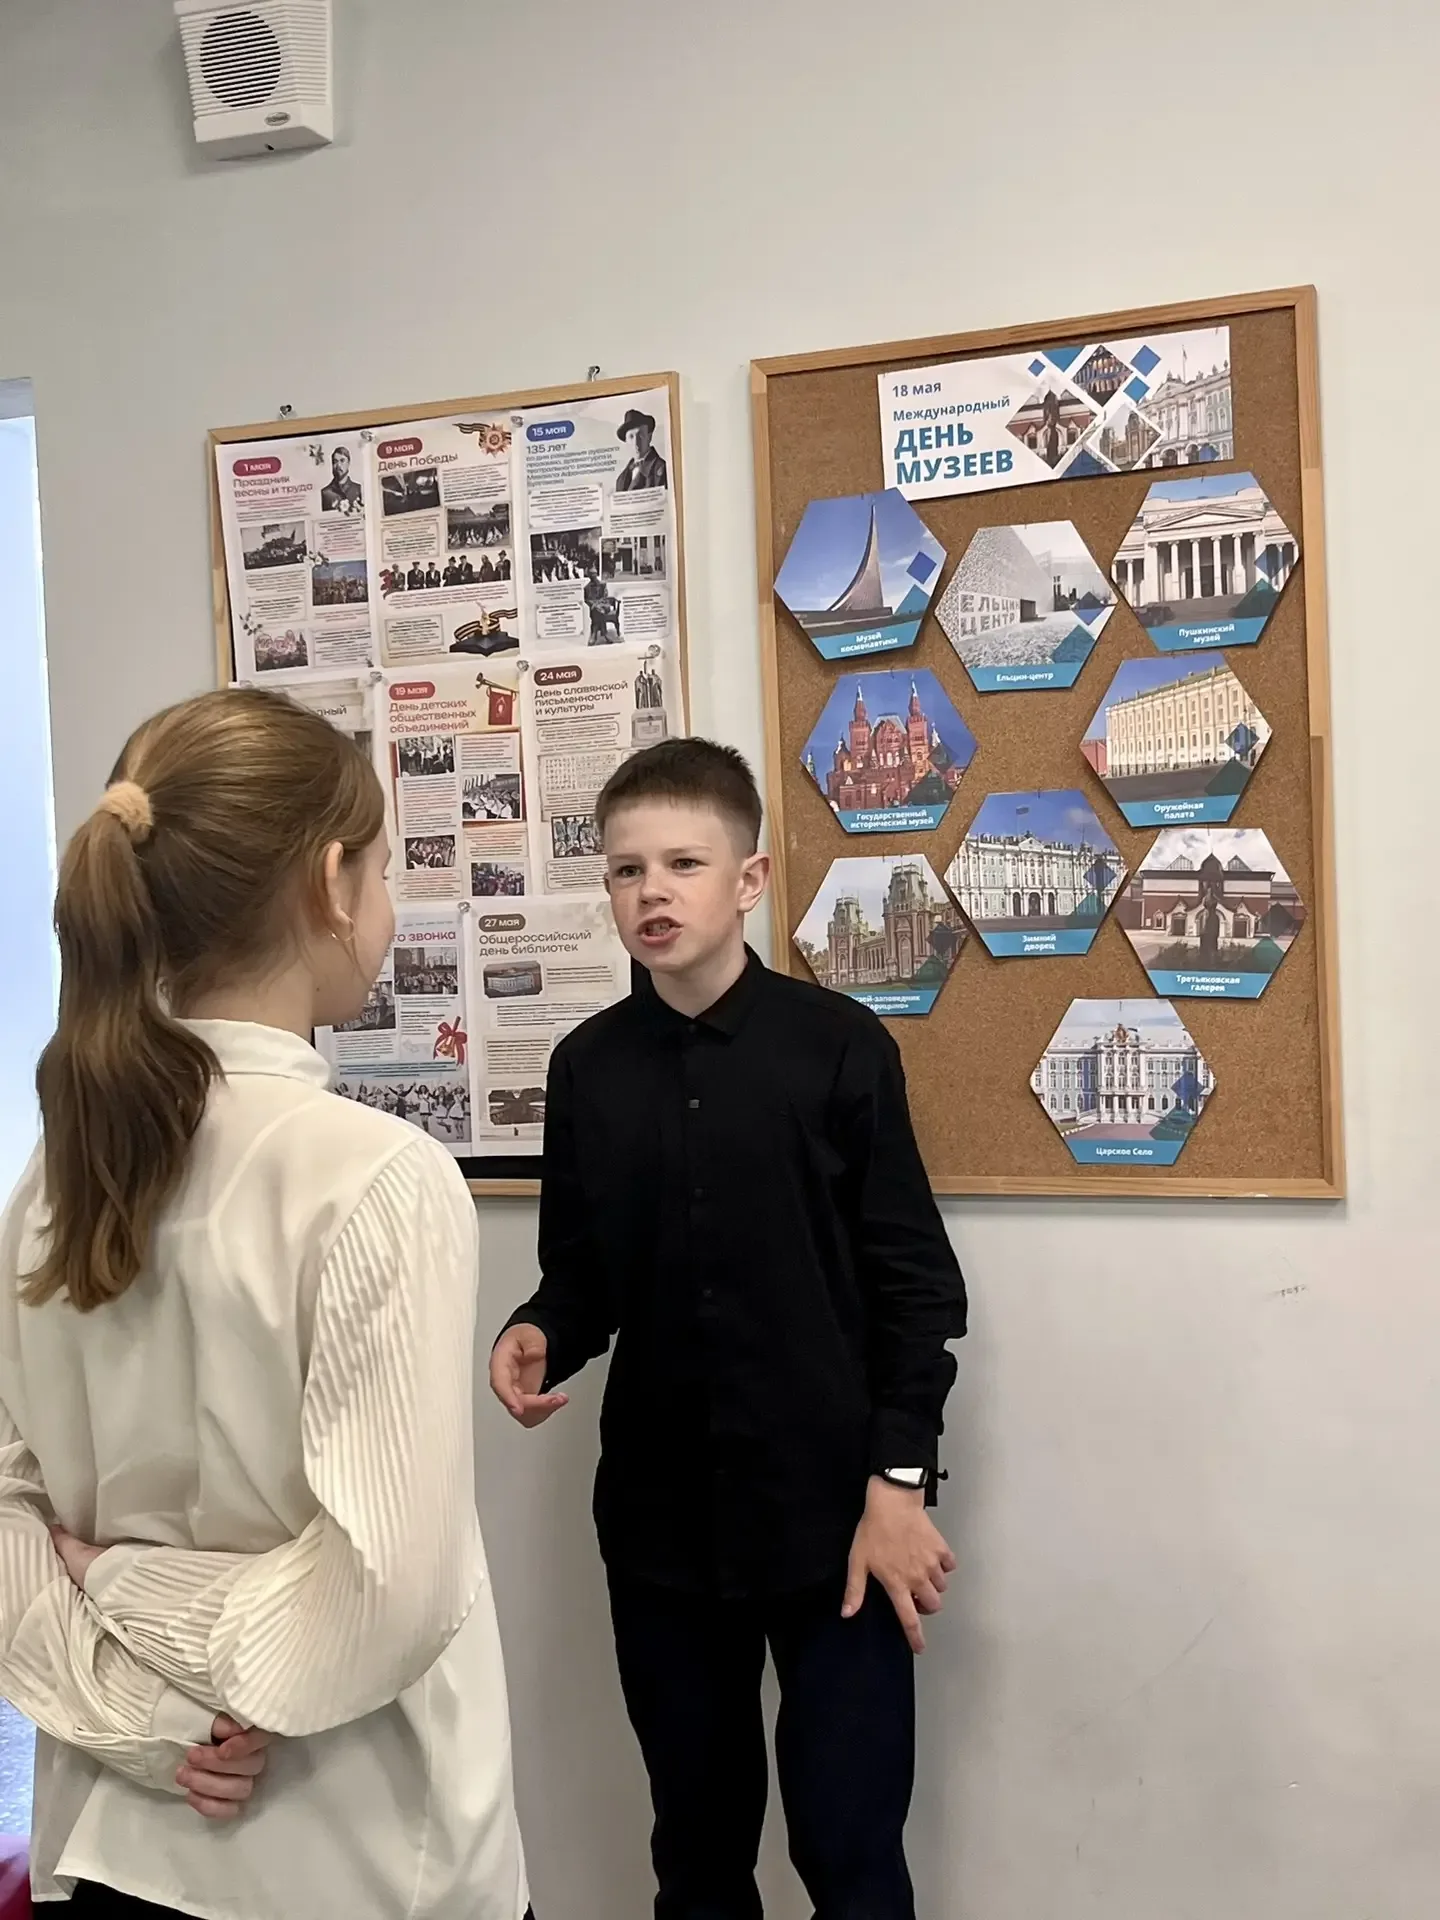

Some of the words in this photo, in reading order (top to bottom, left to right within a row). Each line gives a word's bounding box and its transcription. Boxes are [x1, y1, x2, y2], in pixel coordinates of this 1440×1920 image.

[892, 384, 909, 397] 18
[912, 382, 942, 395] мая
[893, 395, 1011, 422] Международный
[531, 427, 544, 437] 15
[545, 426, 567, 435] мая
[894, 422, 974, 460] ДЕНЬ
[385, 445, 393, 454] 9
[394, 443, 414, 452] мая
[526, 444, 546, 454] 135
[547, 443, 567, 453] лет
[378, 460, 407, 472] День
[409, 453, 459, 466] Победы
[896, 449, 1014, 485] МУЗЕЕВ
[233, 476, 290, 489] Праздник
[234, 487, 270, 498] весны
[271, 486, 280, 494] и
[281, 483, 314, 494] труда
[960, 612, 1015, 637] ЦЕНТР
[1178, 623, 1235, 638] Пушкинский
[855, 632, 882, 644] Музей
[1192, 633, 1221, 644] музей
[840, 638, 899, 653] космонавтики
[540, 671, 554, 681] 24
[555, 670, 578, 680] мая
[996, 672, 1054, 683] Ельцин-центр
[394, 687, 405, 696] 19
[407, 686, 429, 695] мая
[534, 689, 562, 700] День
[563, 680, 629, 696] славянской
[534, 692, 613, 707] письменности
[389, 702, 419, 713] День
[419, 700, 467, 712] детских
[535, 708, 543, 716] и
[544, 703, 595, 717] культуры
[389, 710, 477, 723] общественных
[389, 720, 470, 734] объединений
[856, 809, 928, 821] Государственный
[1153, 802, 1205, 815] Оружейная
[1163, 811, 1195, 820] палата
[850, 818, 907, 829] исторический
[908, 816, 934, 827] музей
[484, 918, 497, 928] 27
[499, 917, 520, 927] мая
[408, 931, 456, 942] звонка
[479, 931, 592, 947] Общероссийский
[1022, 933, 1057, 943] Зимний
[480, 946, 510, 957] день
[511, 943, 579, 955] библиотек
[1024, 943, 1056, 952] дворец
[1176, 974, 1241, 985] Третьяковская
[1190, 984, 1226, 994] галерея
[1095, 1147, 1131, 1157] Царское
[1132, 1147, 1154, 1157] Село
